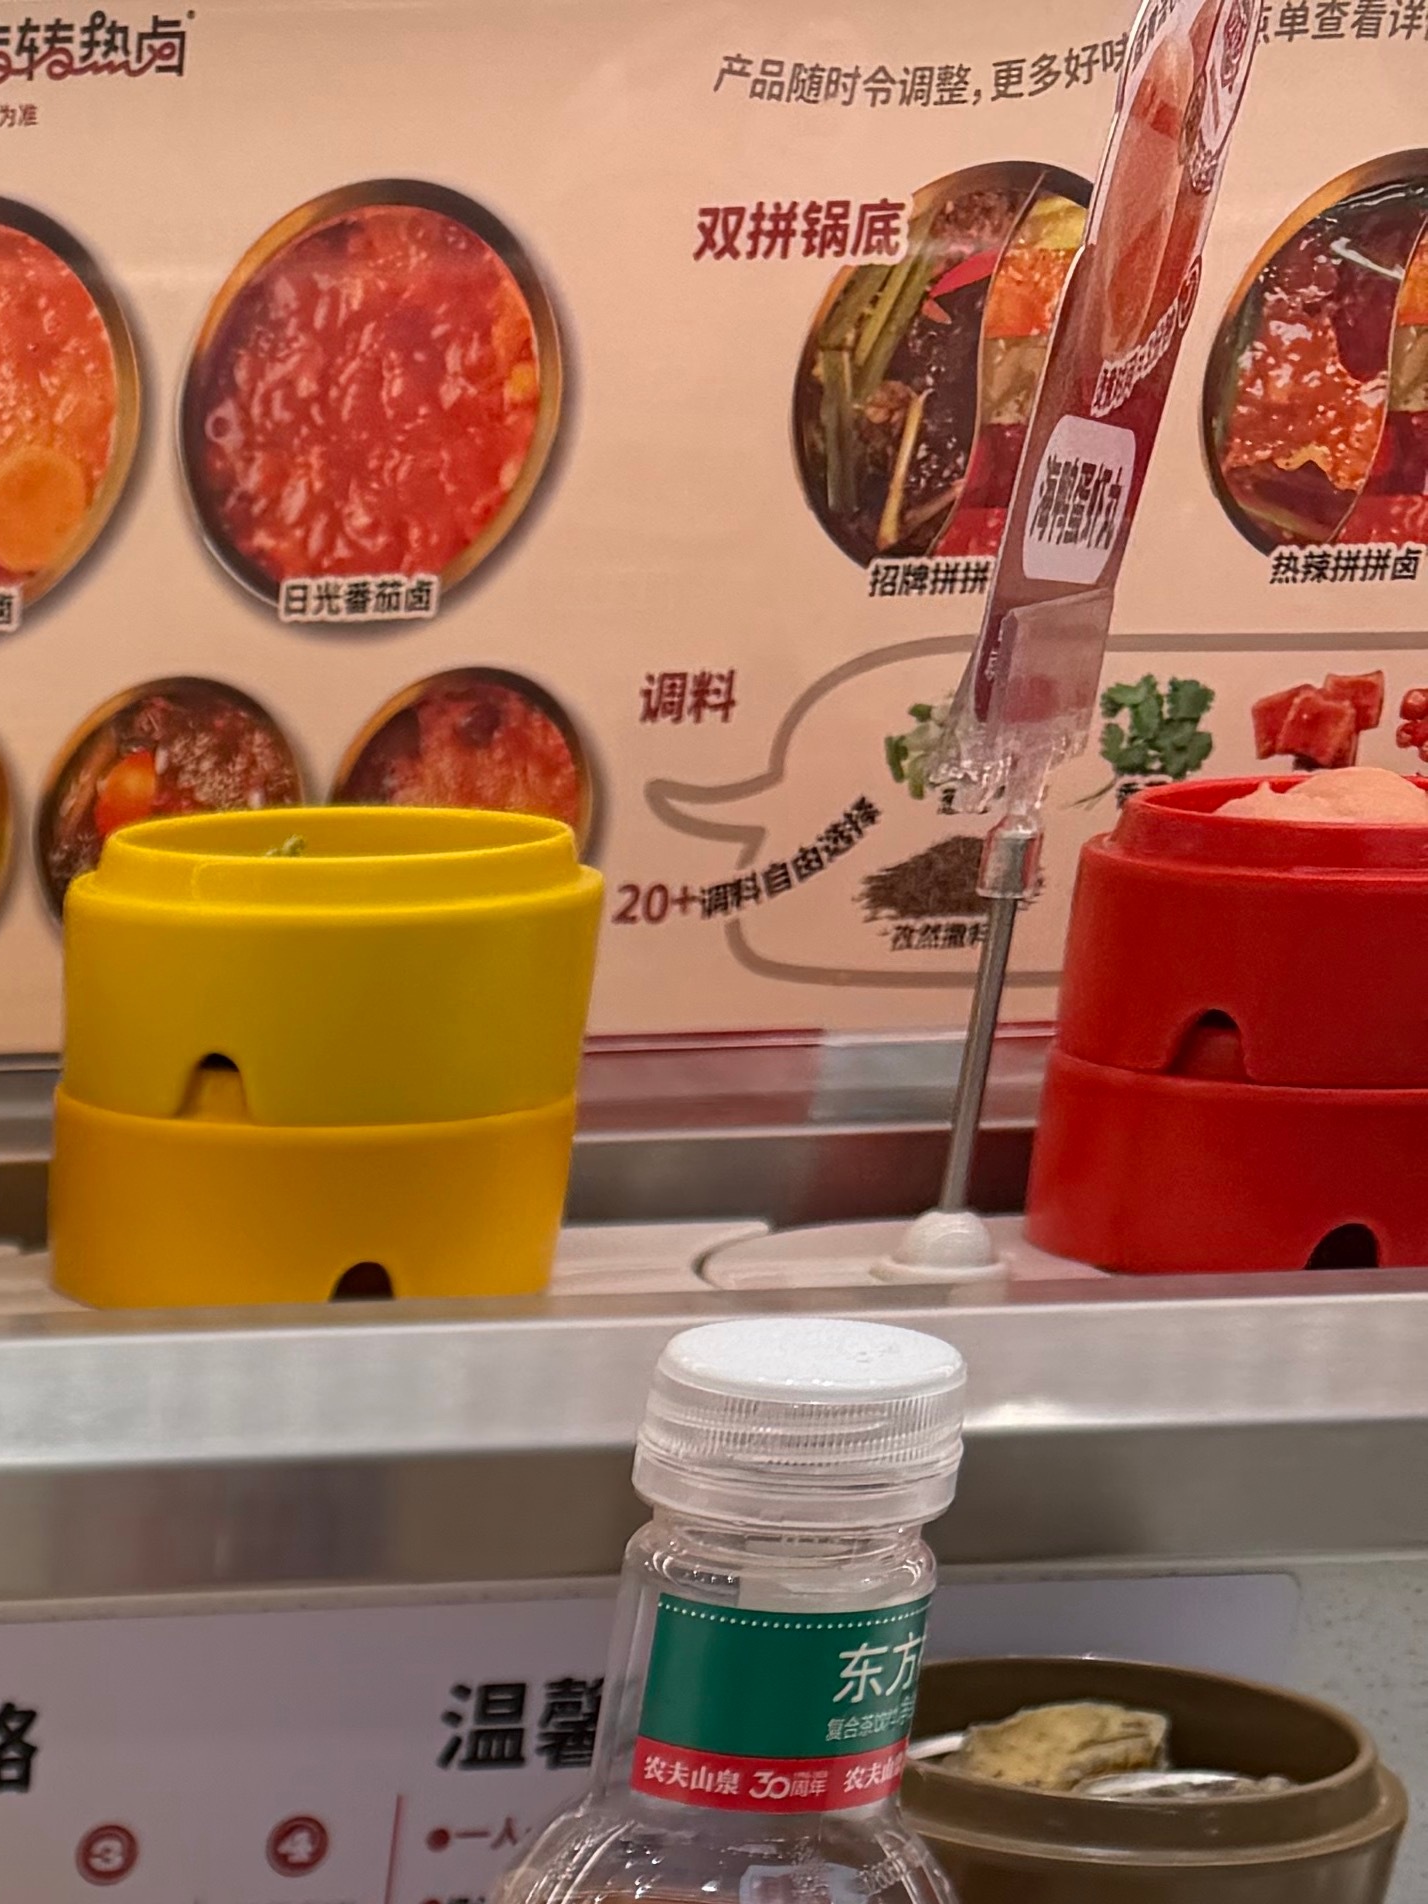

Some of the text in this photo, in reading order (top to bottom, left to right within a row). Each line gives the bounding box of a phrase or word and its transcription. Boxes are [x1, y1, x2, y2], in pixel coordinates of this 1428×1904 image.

[692, 199, 904, 262] 双拼锅底
[639, 670, 737, 725] 调料
[644, 1757, 741, 1795] 农夫山泉
